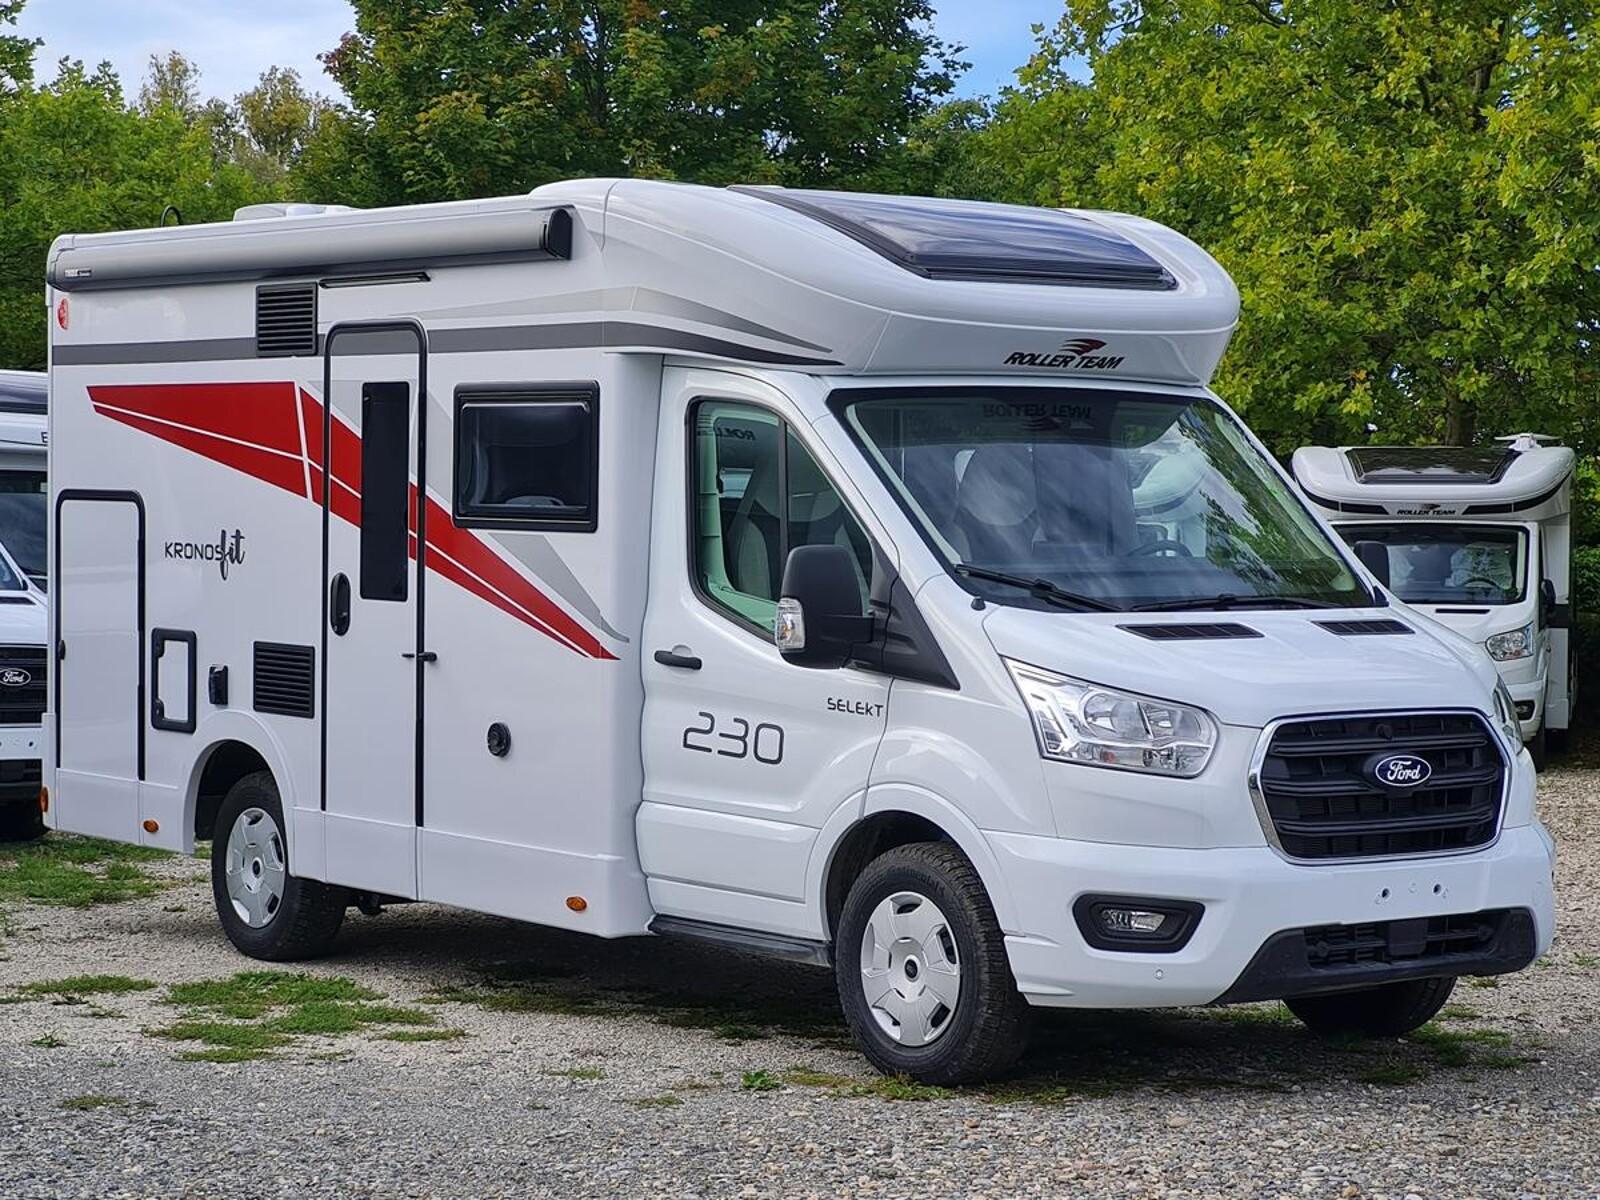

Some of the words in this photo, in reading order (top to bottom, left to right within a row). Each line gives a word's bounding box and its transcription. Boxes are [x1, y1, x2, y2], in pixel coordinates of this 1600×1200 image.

[1003, 351, 1076, 369] ROLLER
[1074, 355, 1125, 369] TEAM
[683, 711, 785, 765] 230
[1387, 760, 1421, 780] Ford
